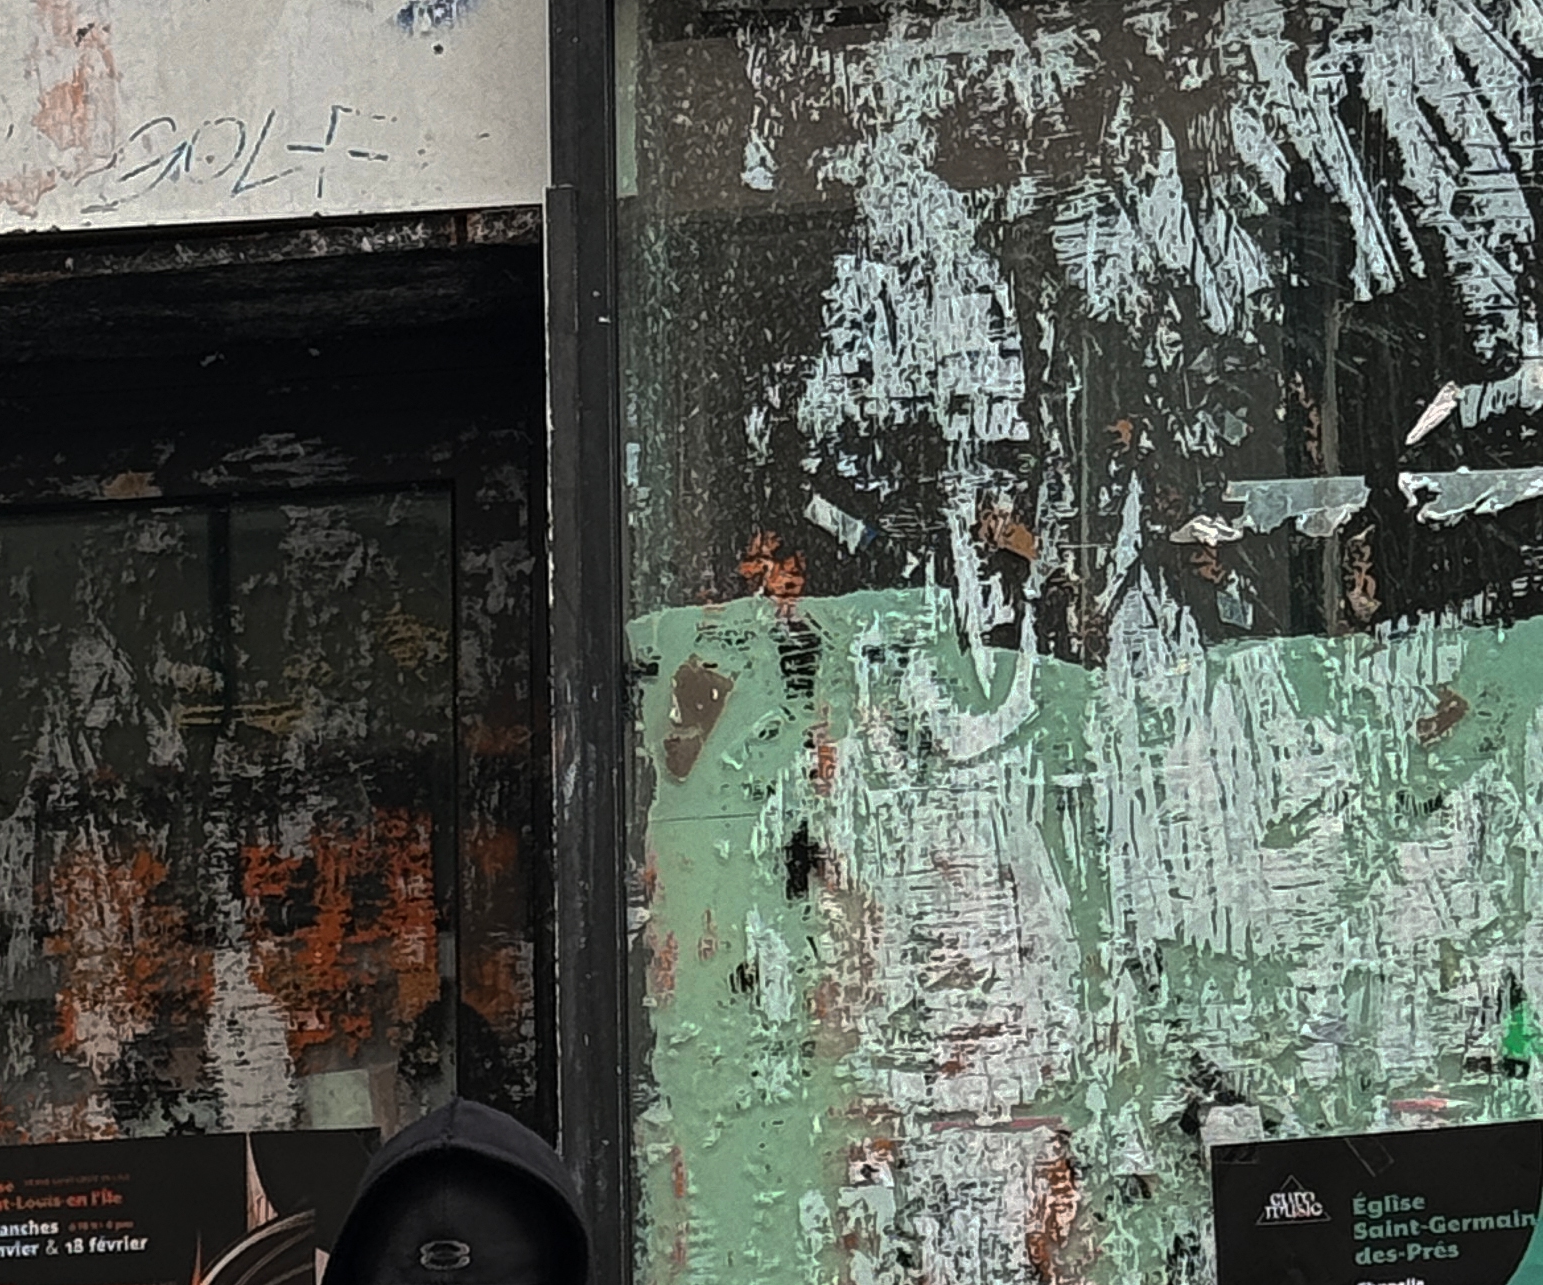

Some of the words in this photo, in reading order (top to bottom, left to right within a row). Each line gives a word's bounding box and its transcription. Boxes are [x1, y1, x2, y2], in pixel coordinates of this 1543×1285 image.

[1269, 1191, 1316, 1208] euro
[1353, 1191, 1425, 1219] Église
[1264, 1201, 1324, 1220] music
[45, 1238, 59, 1256] &
[65, 1238, 85, 1254] 18
[89, 1235, 149, 1252] février
[1355, 1241, 1460, 1265] des-Prés
